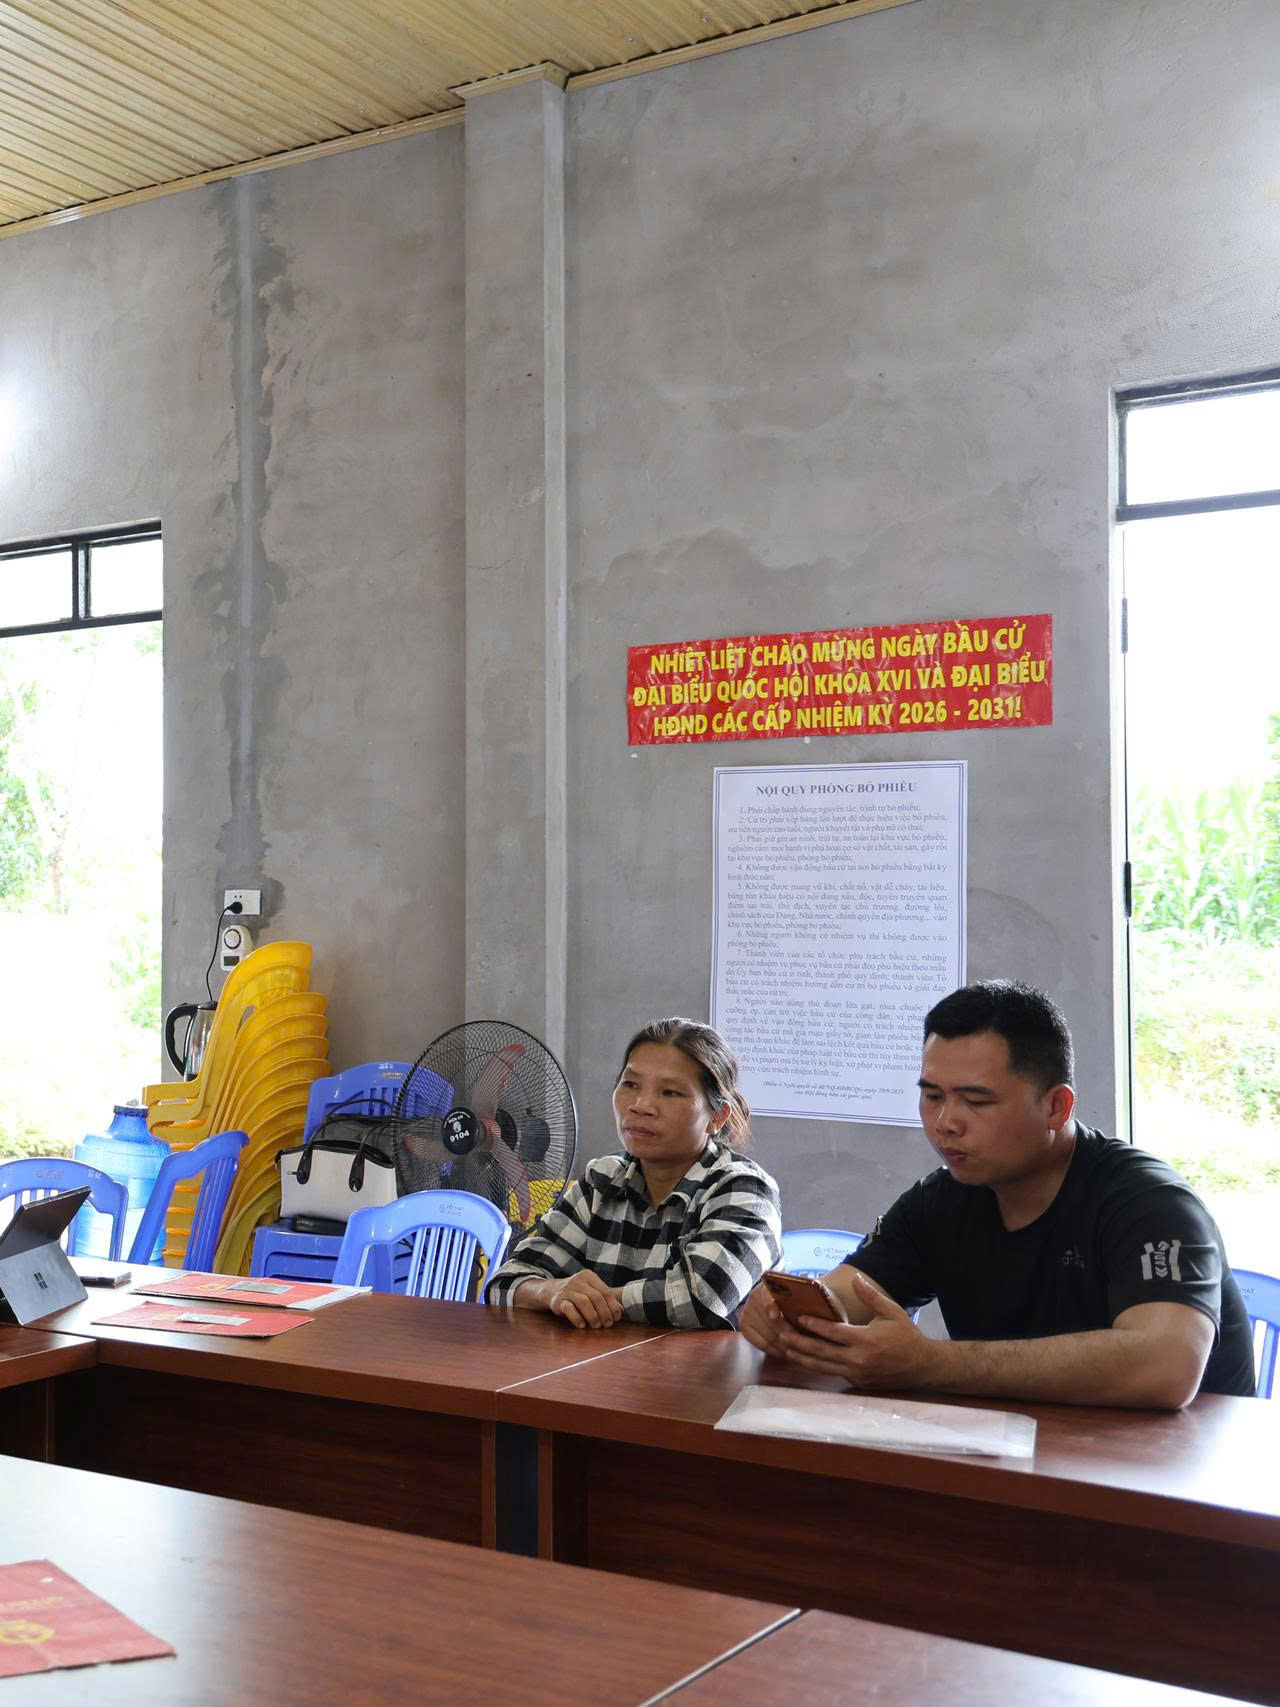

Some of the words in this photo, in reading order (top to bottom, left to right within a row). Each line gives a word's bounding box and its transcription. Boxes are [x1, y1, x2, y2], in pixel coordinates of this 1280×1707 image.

[650, 646, 706, 677] NHIỆT
[710, 642, 746, 674] LIỆT
[751, 639, 808, 667] CHÀO
[811, 634, 876, 663] MỪNG
[881, 628, 937, 658] NGÀY
[943, 623, 988, 654] BẦU
[993, 619, 1027, 651] CỬ
[633, 685, 666, 710] ĐẠI
[671, 676, 712, 706] BIỂU
[717, 670, 769, 702] QUỐC
[773, 669, 809, 703] HỘI
[814, 667, 872, 696] KHÓA
[876, 669, 911, 692] XVI
[917, 661, 946, 690] VÀ
[952, 664, 991, 691] ĐẠI
[997, 651, 1046, 686] BIỂU
[653, 713, 707, 736] HĐND
[711, 706, 748, 733] CÁC
[751, 701, 792, 732] CẤP
[796, 699, 862, 732] NHIỆM
[868, 696, 894, 725] KỲ
[899, 700, 947, 724] 2026
[967, 695, 1022, 721] 2031!
[781, 784, 807, 796] QUY
[449, 1129, 470, 1143] 9104
